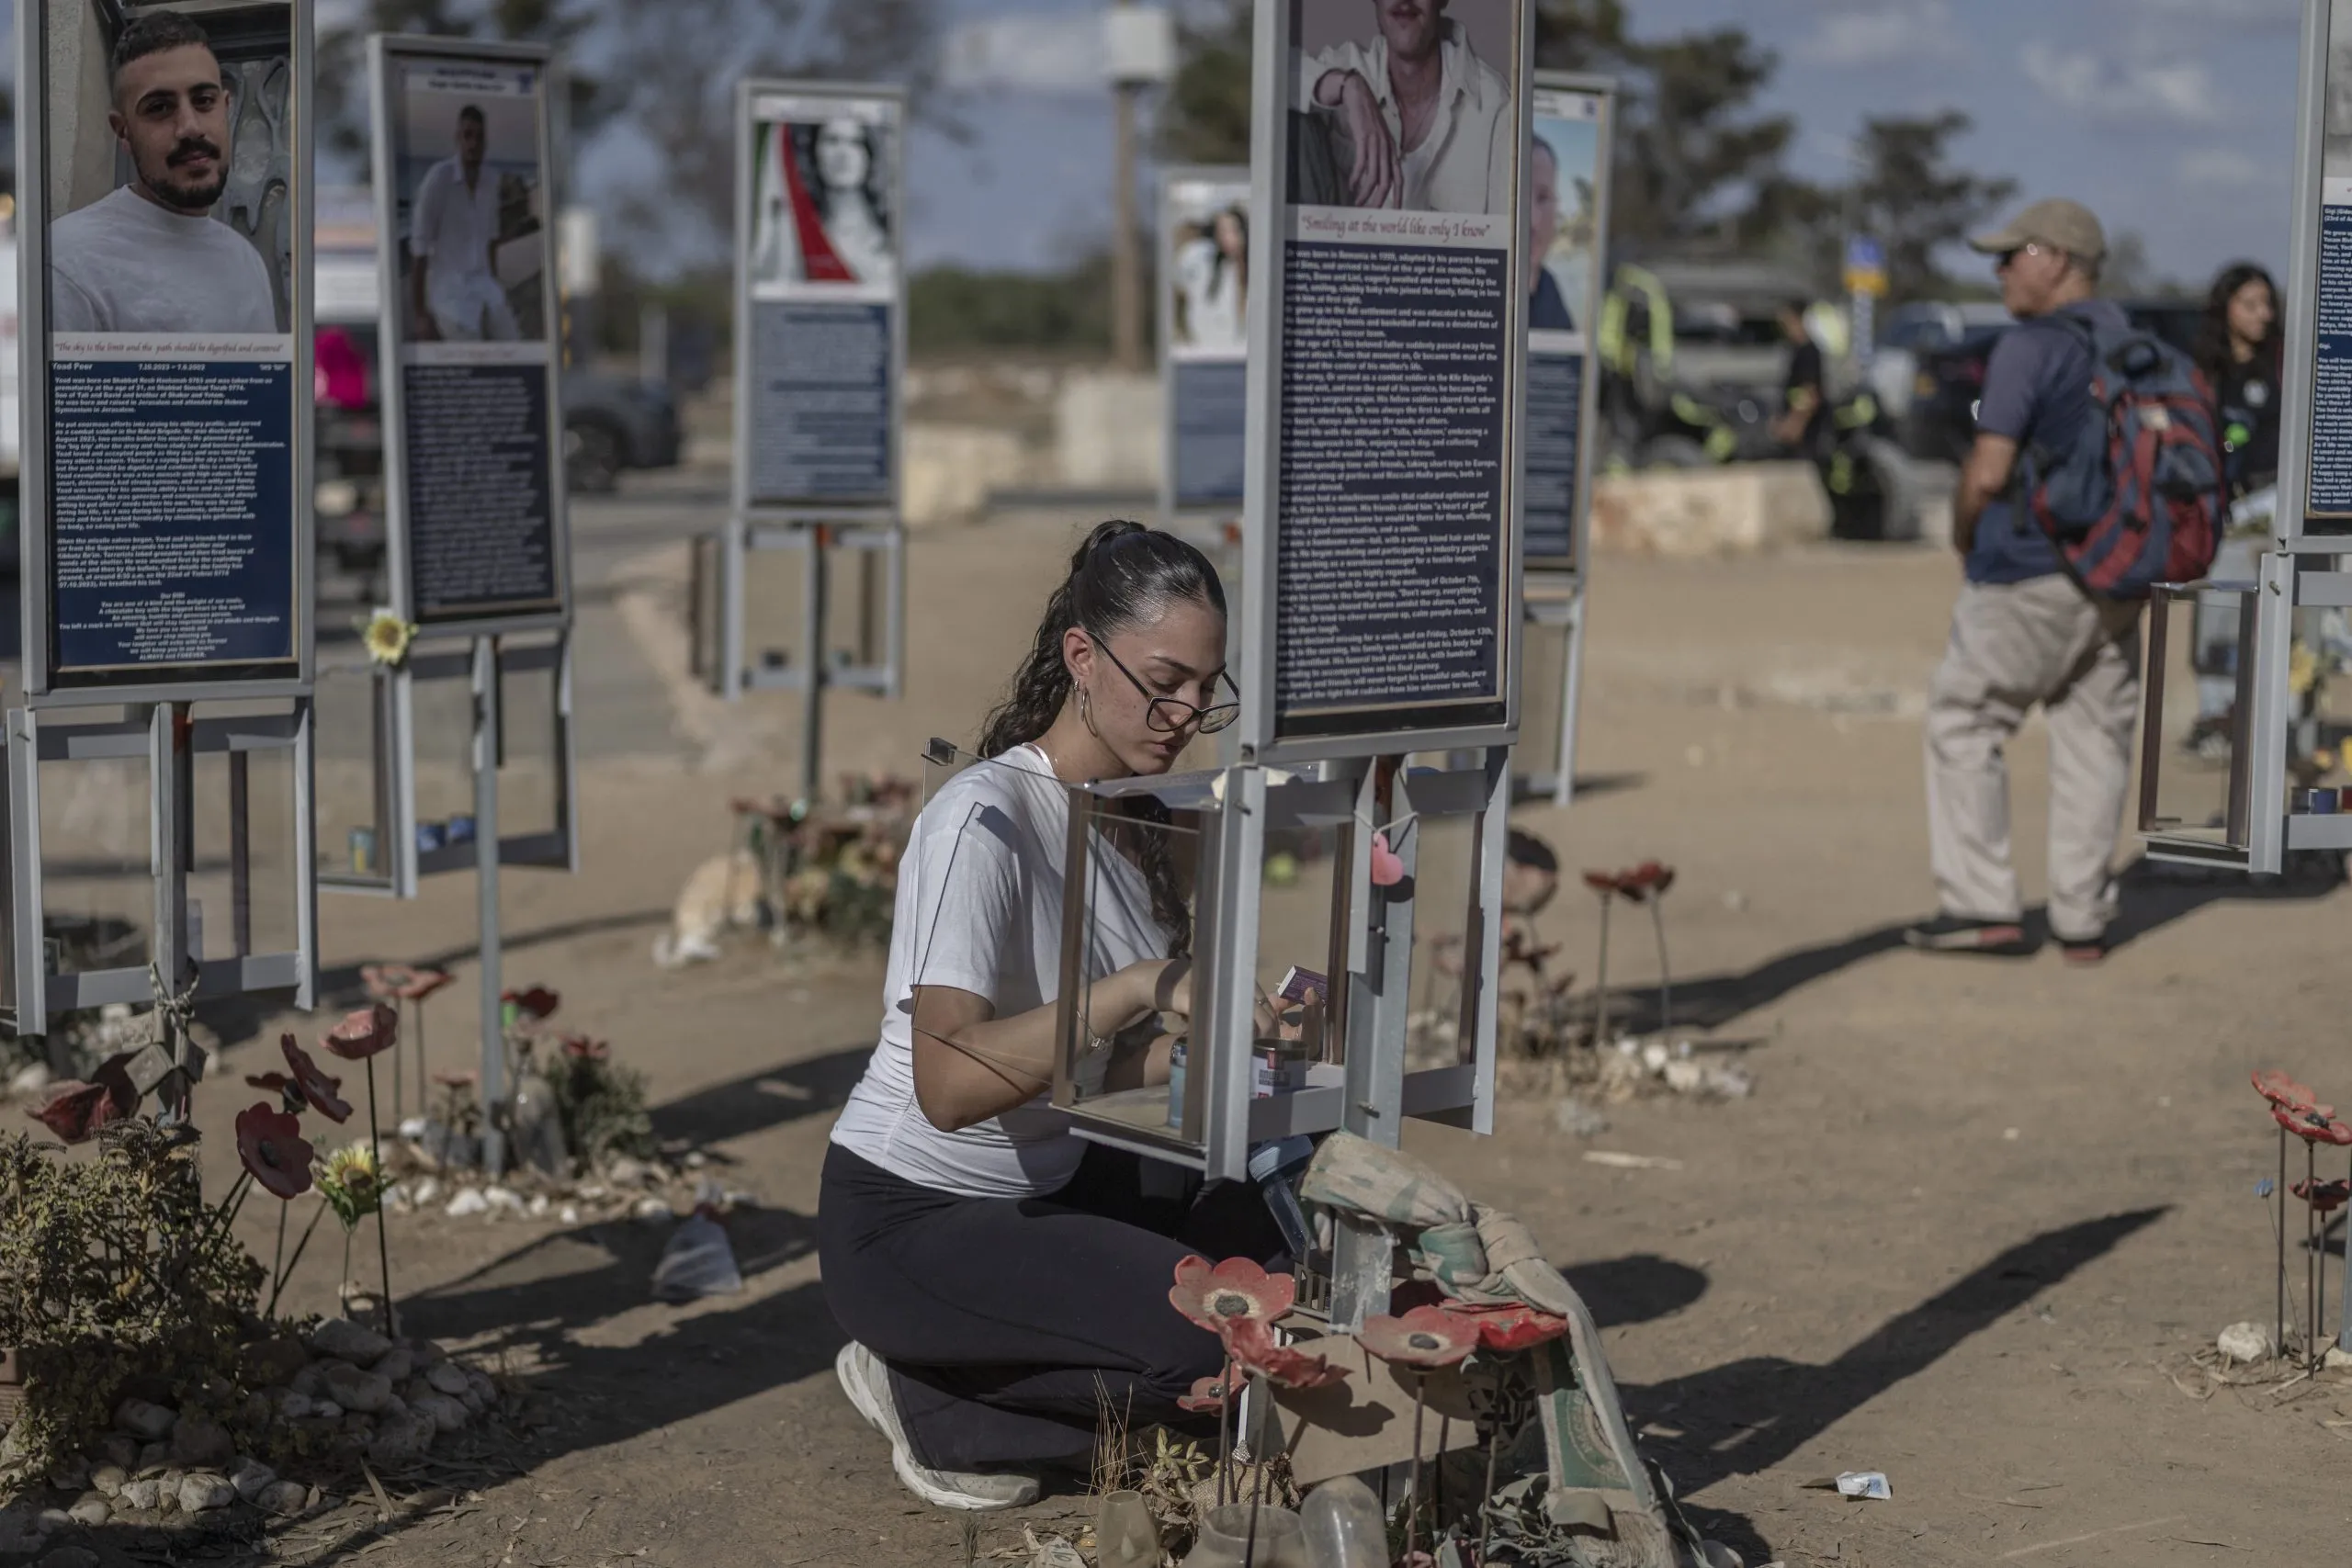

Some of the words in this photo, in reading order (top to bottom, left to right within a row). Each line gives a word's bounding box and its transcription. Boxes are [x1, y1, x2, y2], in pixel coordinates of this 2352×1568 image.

[1348, 220, 1359, 232] at
[1362, 214, 1377, 233] the
[1380, 217, 1410, 234] world
[1410, 217, 1427, 235] like
[1429, 218, 1450, 243] only
[1452, 223, 1459, 237] I
